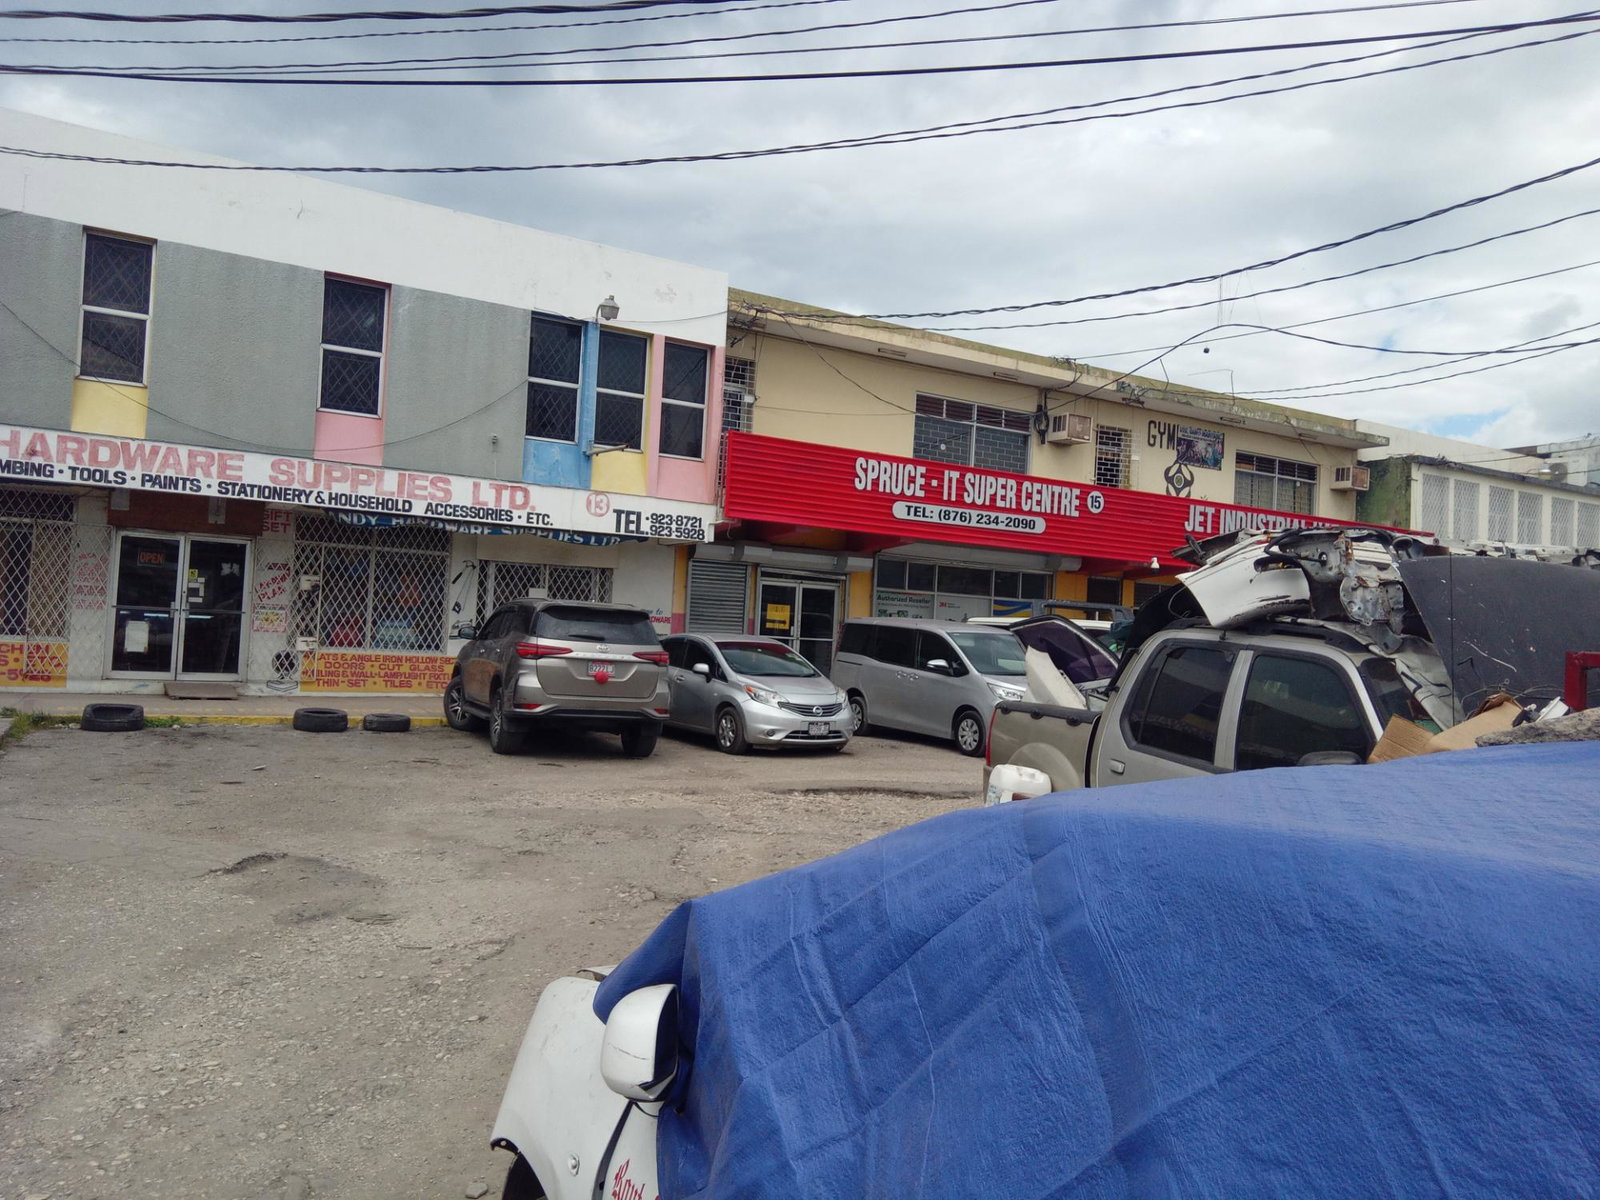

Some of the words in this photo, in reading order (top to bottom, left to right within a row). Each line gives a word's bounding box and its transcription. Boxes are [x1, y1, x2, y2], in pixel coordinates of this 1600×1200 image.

[1147, 420, 1176, 450] GYM
[0, 429, 245, 481] HARDWARE
[269, 458, 453, 503] SUPPLIES
[471, 480, 536, 511] LTD.
[68, 466, 127, 485] TOOLS
[141, 473, 202, 493] PAINTS
[218, 480, 314, 504] STATIONERY
[328, 492, 412, 513] HOUSEHOLD
[424, 502, 514, 522] ACCESSORIES
[526, 512, 554, 526] ETC.
[854, 456, 927, 497] SPRUCE
[943, 470, 960, 501] IT
[963, 472, 1017, 509] SUPER
[1021, 480, 1081, 517] CENTRE
[1090, 495, 1102, 510] 15
[262, 521, 291, 533] SET
[905, 504, 934, 519] TEL:
[938, 508, 972, 524] (876)
[976, 513, 1036, 530] 234-2090
[1184, 504, 1216, 533] JET
[324, 661, 365, 670] DOORS
[382, 679, 413, 689] TILES
